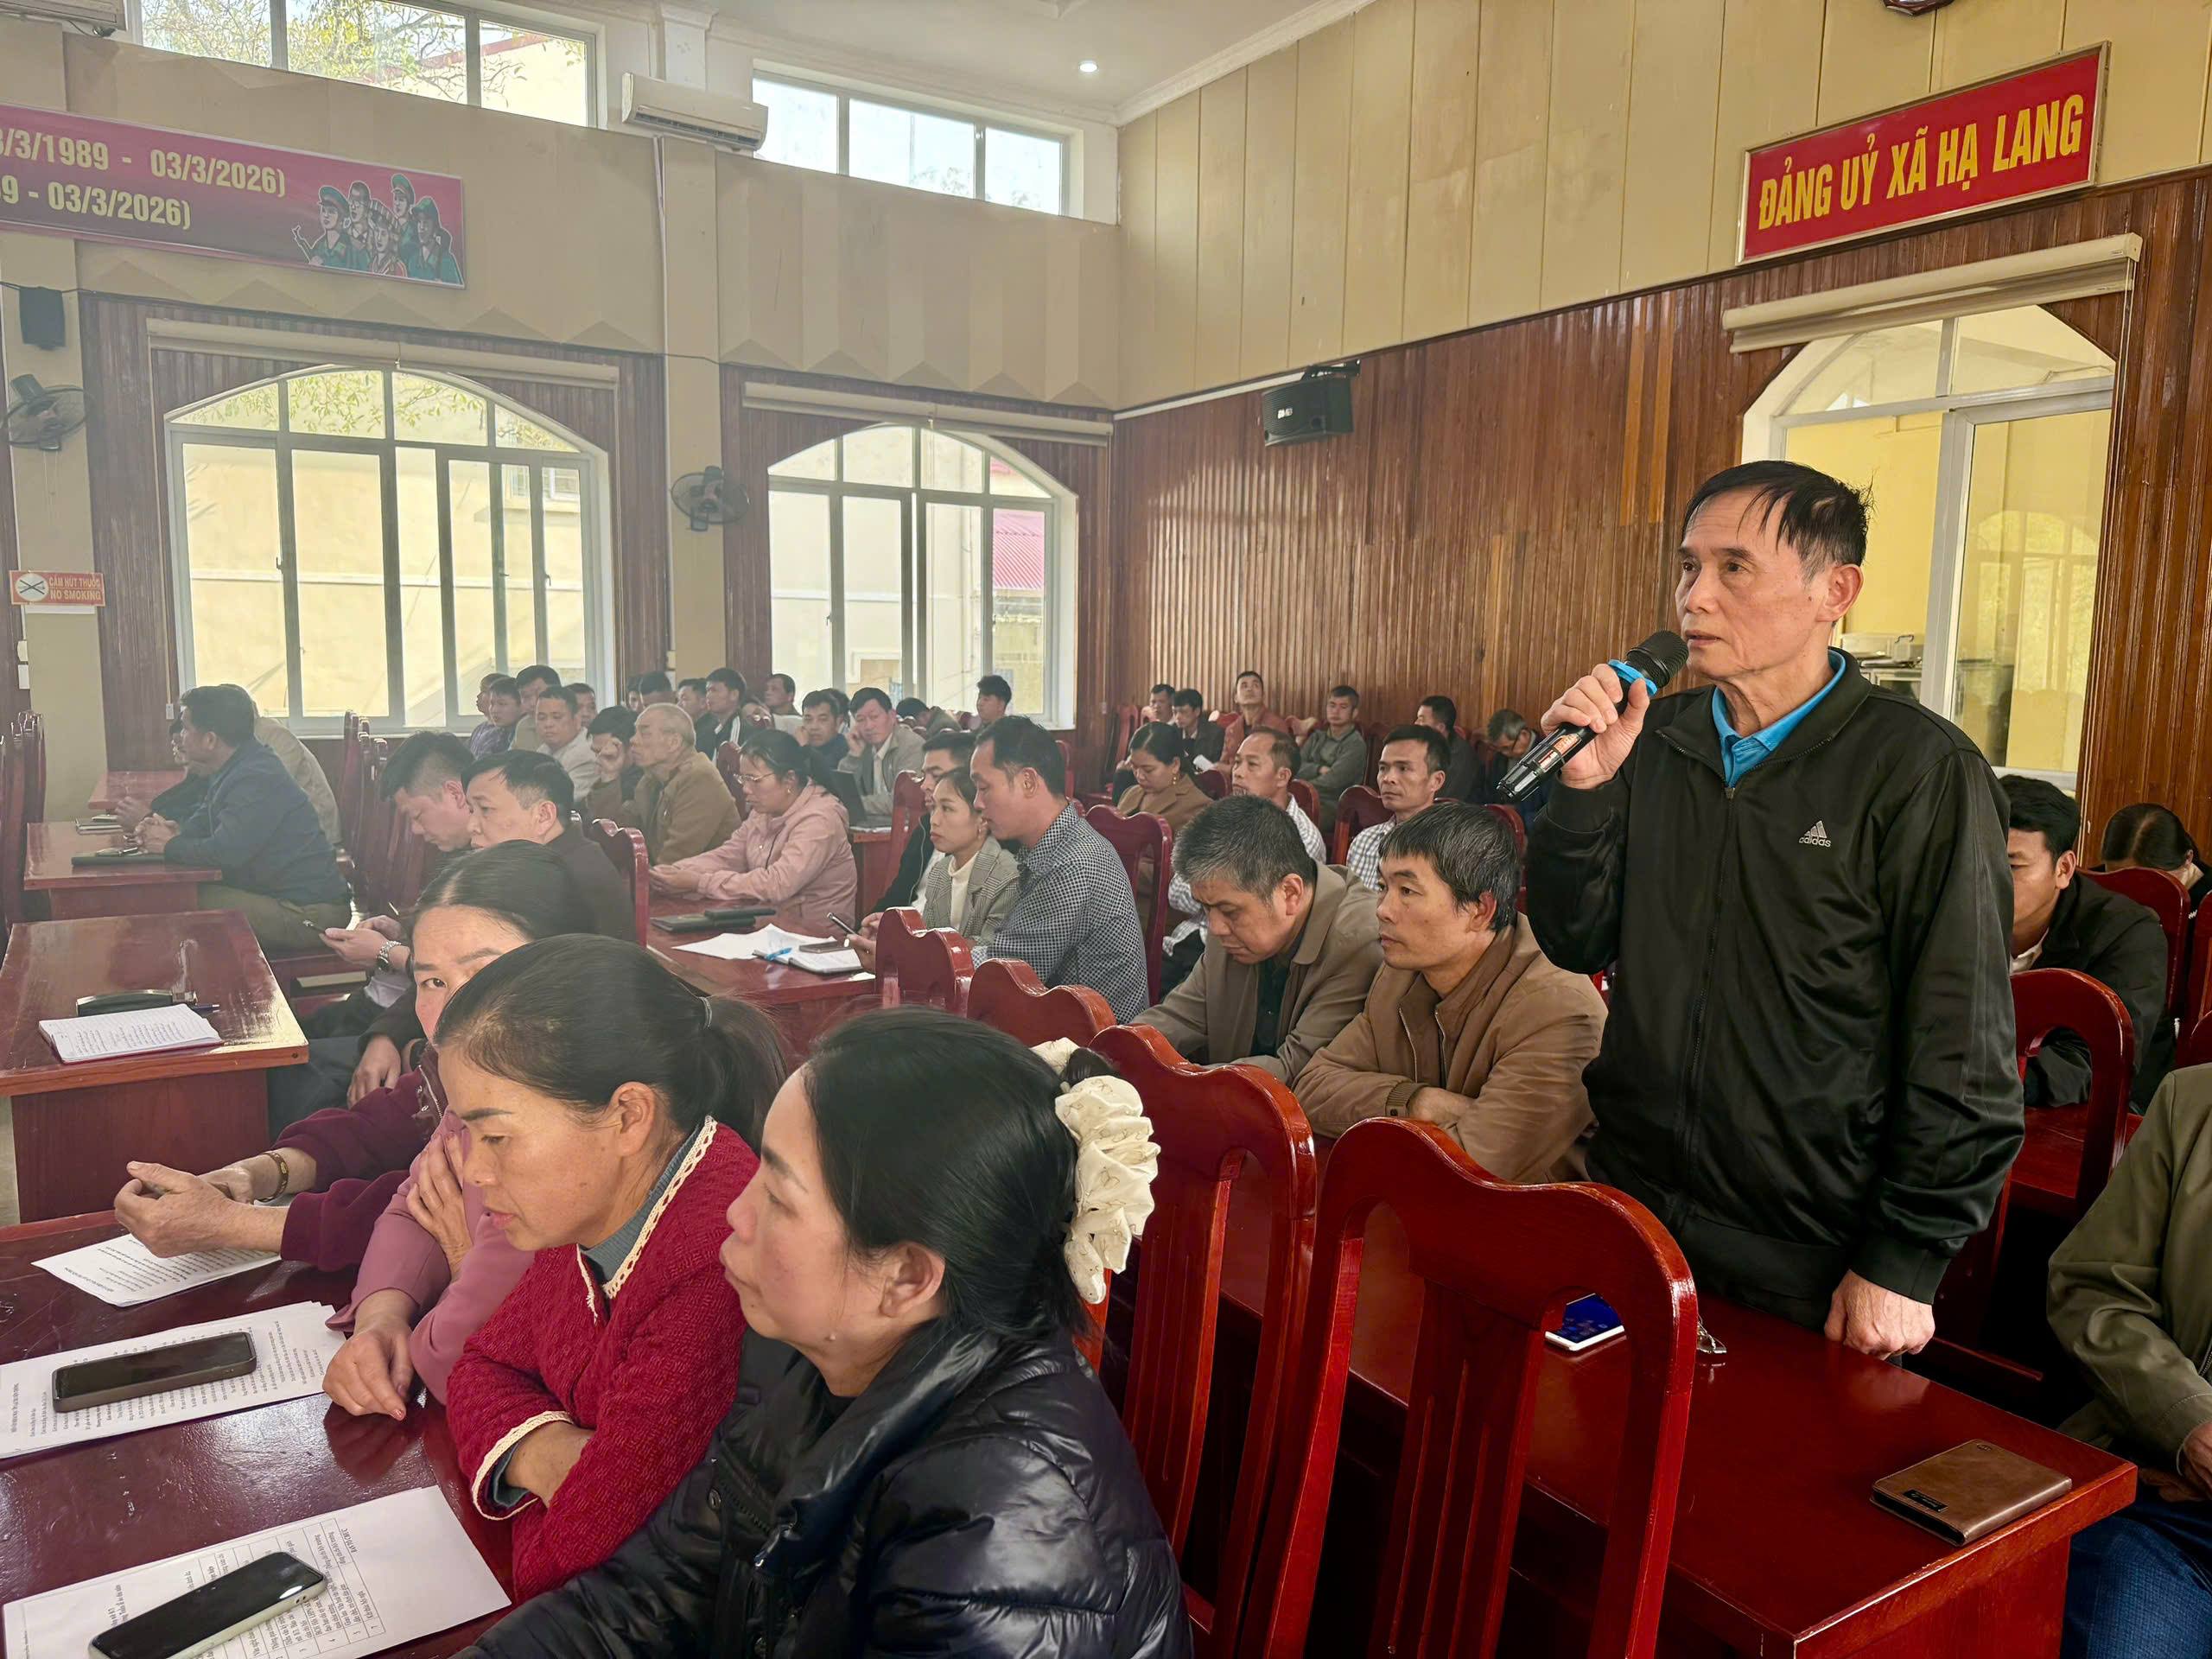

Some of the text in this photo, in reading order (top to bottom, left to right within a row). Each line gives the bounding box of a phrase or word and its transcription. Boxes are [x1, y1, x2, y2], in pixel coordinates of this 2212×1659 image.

[0, 128, 109, 170] /3/1989
[150, 149, 286, 197] 03/3/2026)
[1758, 94, 2085, 231] ĐẢNG UỶ XÃ HẠ LANG
[48, 181, 191, 230] 03/3/2026)
[50, 589, 102, 601] NO SMOKING
[1798, 835, 1832, 848] adidas
